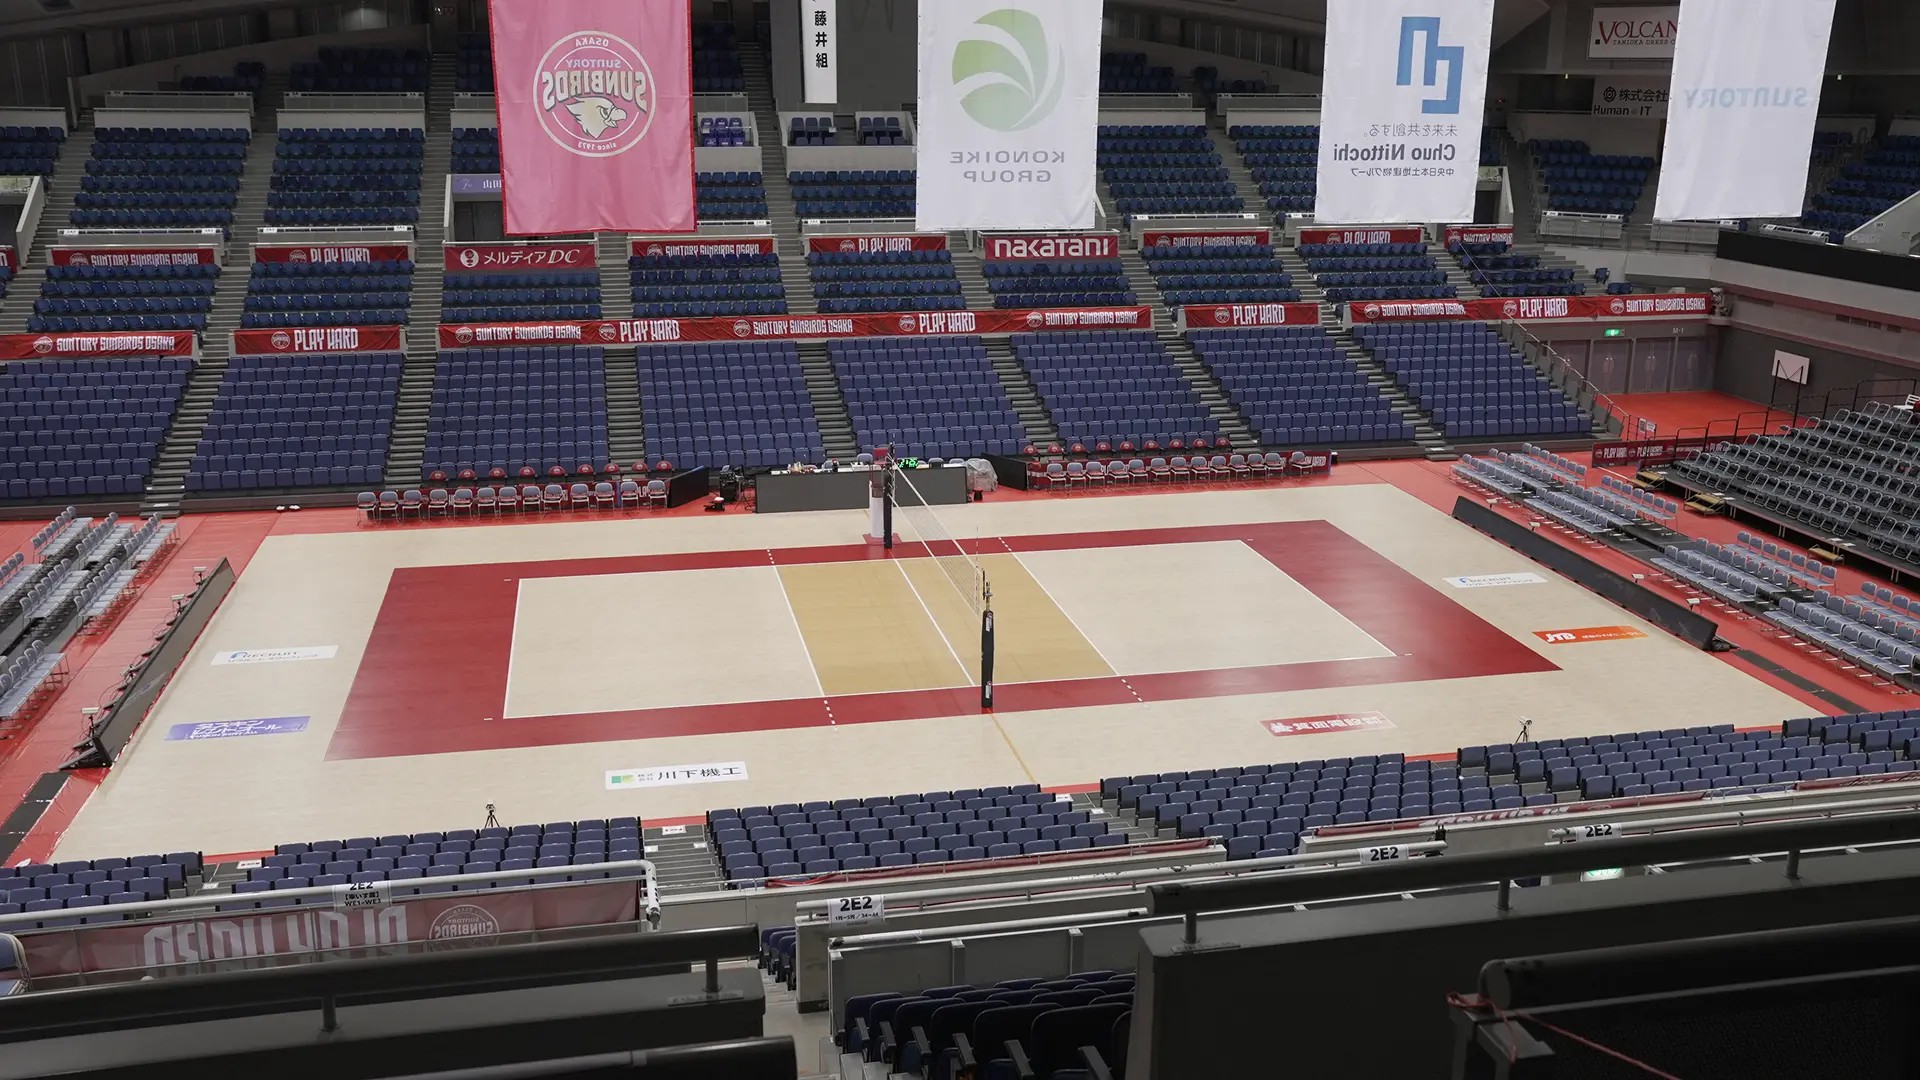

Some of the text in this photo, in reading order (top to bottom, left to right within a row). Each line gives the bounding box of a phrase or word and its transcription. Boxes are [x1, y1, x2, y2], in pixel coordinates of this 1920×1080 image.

[814, 11, 828, 68] 藤井組
[1599, 20, 1678, 45] VOLCAN
[1620, 88, 1668, 102] 株式会社
[1593, 104, 1652, 116] Human IT
[1381, 304, 1412, 317] SUNTORY
[1412, 303, 1445, 316] SUNBIRDS
[1520, 298, 1568, 318] PLAY HARD
[1626, 298, 1706, 312] SUNTORY SUNBIRDS OSAKA
[919, 312, 976, 333] PLAY HARD
[1045, 312, 1079, 326] SUNTORY
[1079, 311, 1114, 325] SUNBIRDS
[1233, 304, 1285, 325] PLAY HARD
[476, 325, 581, 341] SUNTORY SUNBIRDS OSAKA
[620, 319, 681, 343] PLAY HARD
[753, 319, 854, 336] SUNTORY SUNBIRDS OSAKA
[56, 336, 175, 352] SUNTORY SUNBIRDS OSAKA
[293, 328, 359, 351] PLAY HARD
[1545, 632, 1576, 643] JTB
[658, 767, 742, 780] 川下機工
[1584, 824, 1613, 838] 2E2
[1370, 846, 1399, 862] 2E2
[839, 896, 873, 912] 2E2
